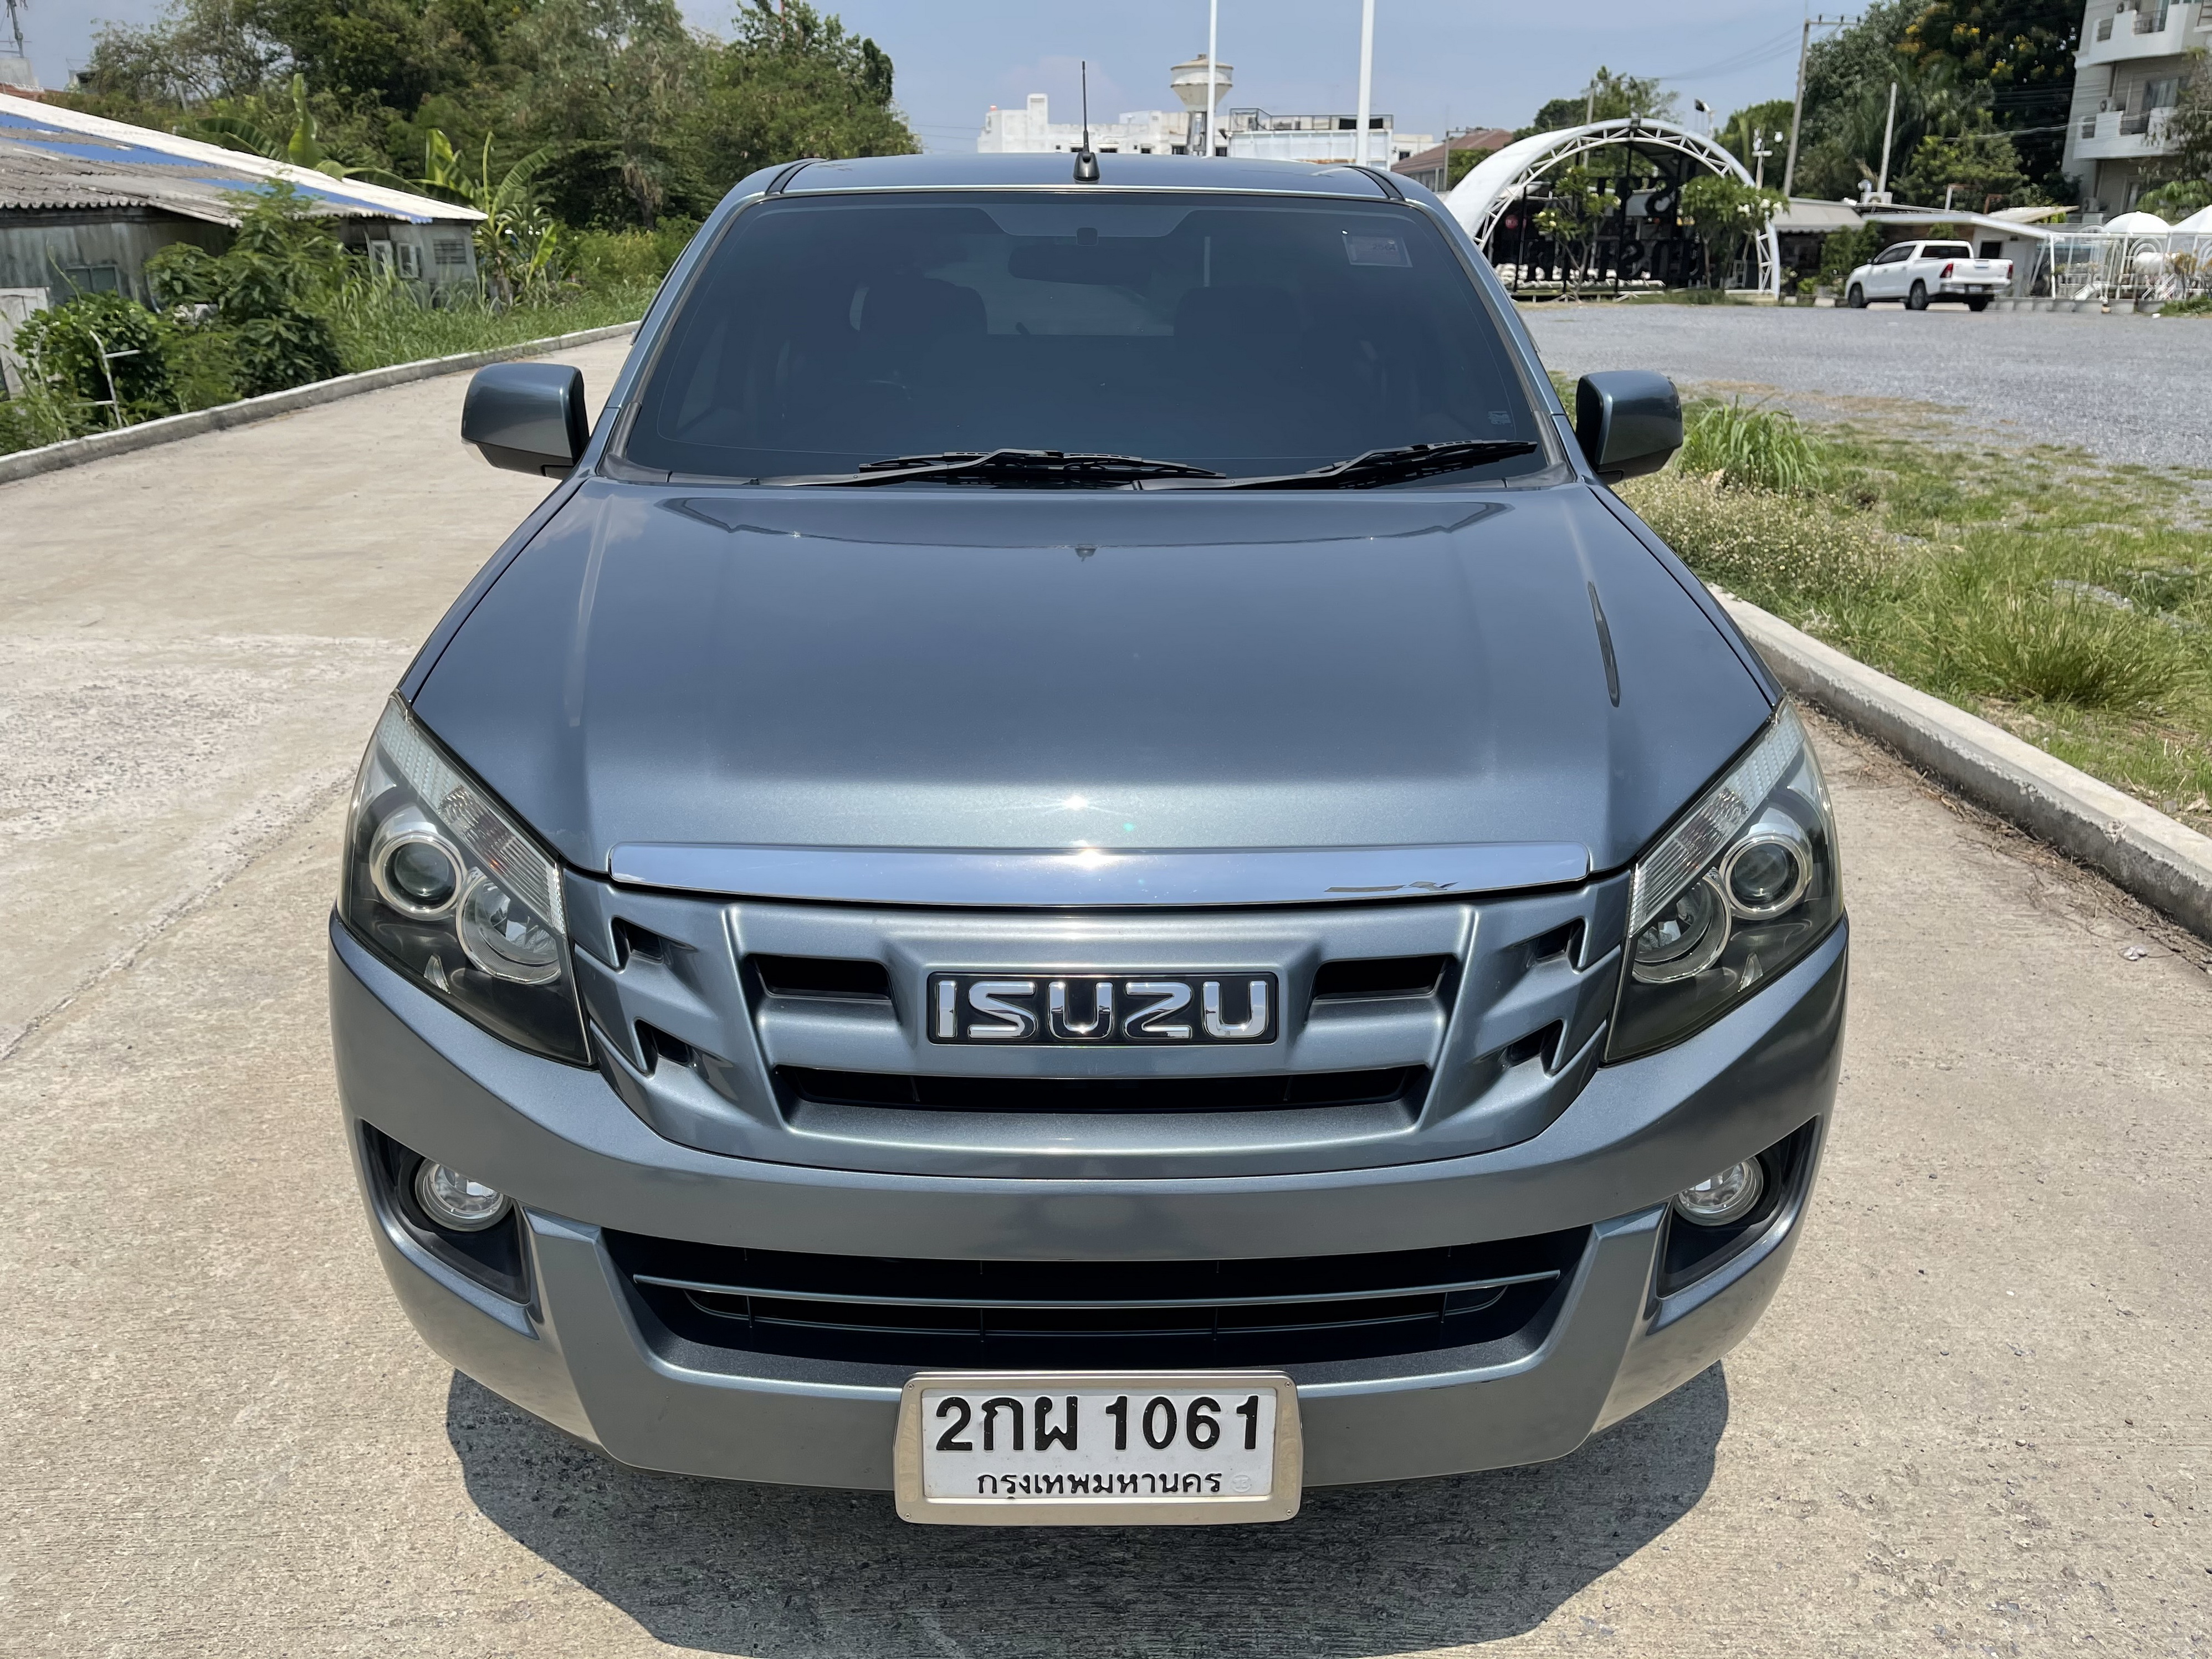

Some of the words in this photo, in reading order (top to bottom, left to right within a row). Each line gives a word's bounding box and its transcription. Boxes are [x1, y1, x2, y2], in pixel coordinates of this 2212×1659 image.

[938, 980, 1268, 1040] ISUZU
[935, 1395, 1079, 1452] 2กผ
[1105, 1395, 1259, 1451] 1061
